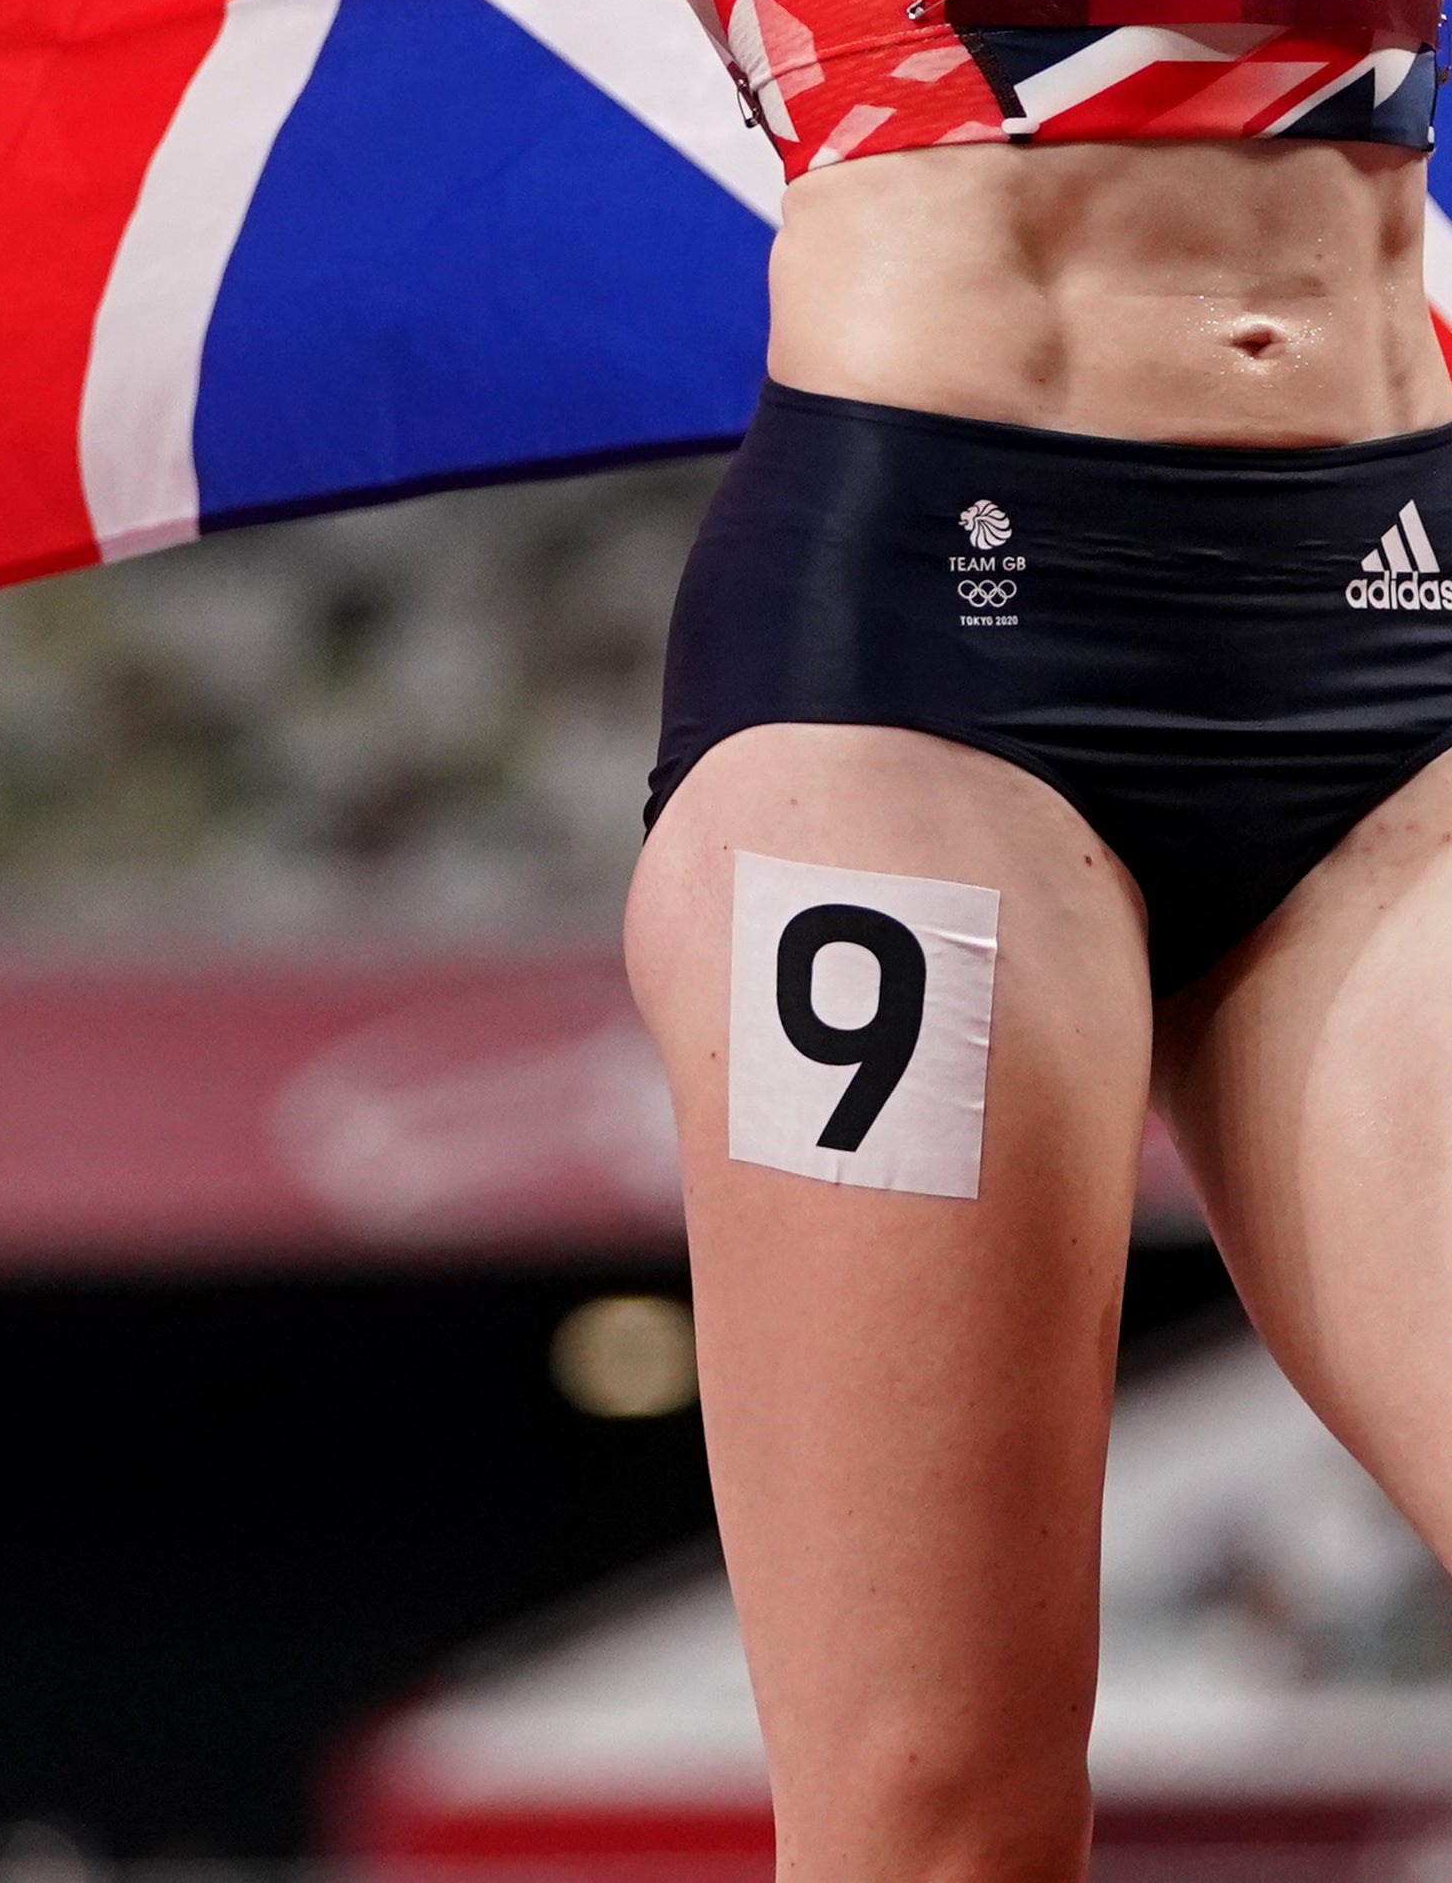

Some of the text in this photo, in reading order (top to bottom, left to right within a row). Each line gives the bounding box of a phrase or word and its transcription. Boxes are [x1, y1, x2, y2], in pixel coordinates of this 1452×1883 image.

[949, 556, 1027, 572] TEAM GB
[960, 615, 1019, 626] TOKYO 2020
[776, 902, 927, 1153] 9
